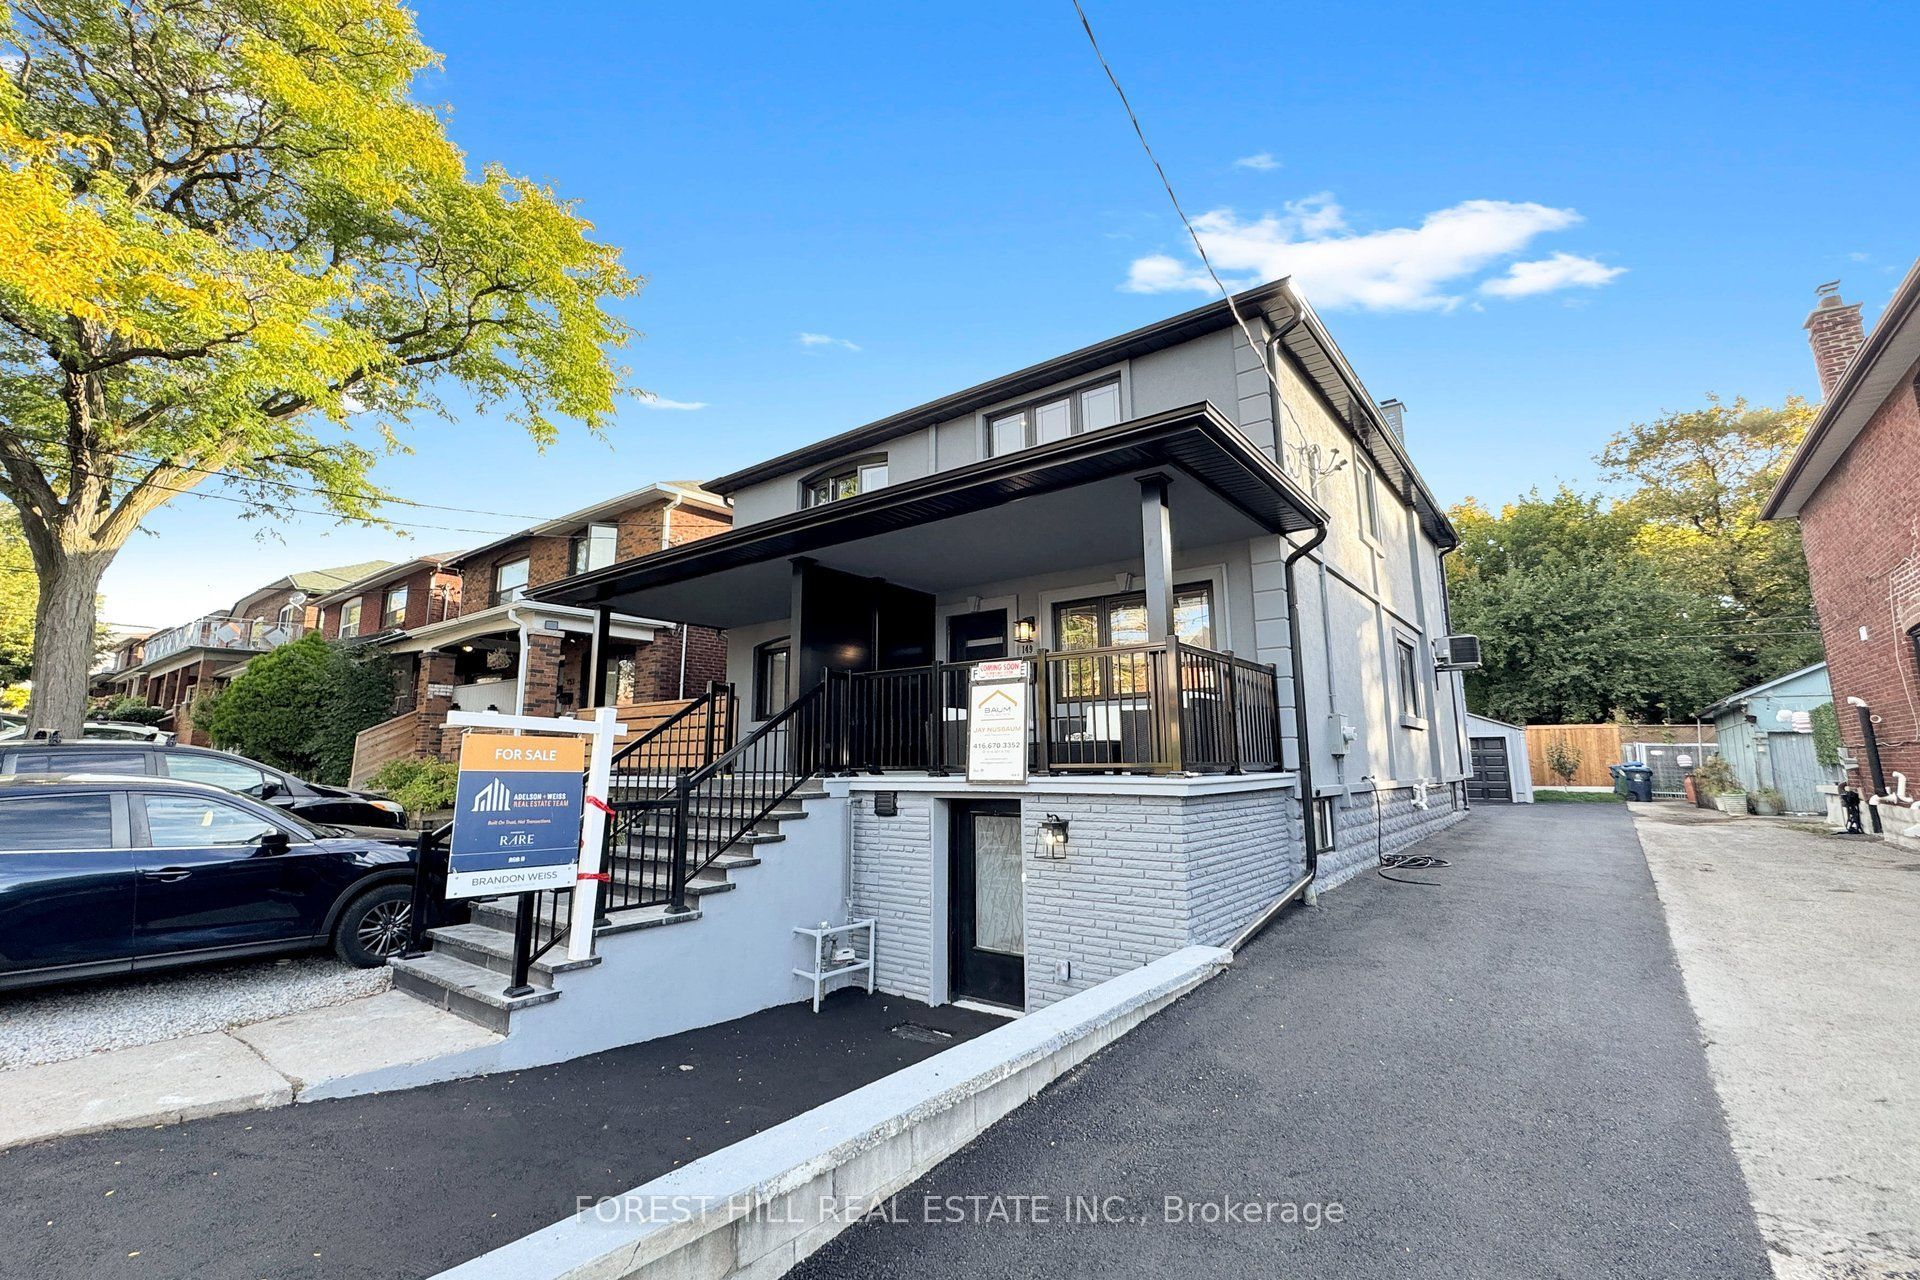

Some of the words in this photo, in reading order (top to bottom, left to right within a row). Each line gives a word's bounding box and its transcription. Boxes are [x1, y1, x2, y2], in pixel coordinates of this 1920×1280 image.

[1022, 644, 1034, 654] 149
[980, 664, 1002, 672] COMING
[1003, 662, 1020, 671] SOON
[984, 706, 1011, 714] BAUM
[495, 749, 522, 761] FOR
[525, 749, 557, 761] SALE
[547, 792, 567, 800] WEISS
[512, 800, 529, 808] REAL
[529, 799, 552, 807] ESTATE
[552, 799, 569, 807] TEAM
[499, 833, 535, 846] RARE
[471, 874, 525, 886] BRANDON
[527, 870, 559, 881] WEISS
